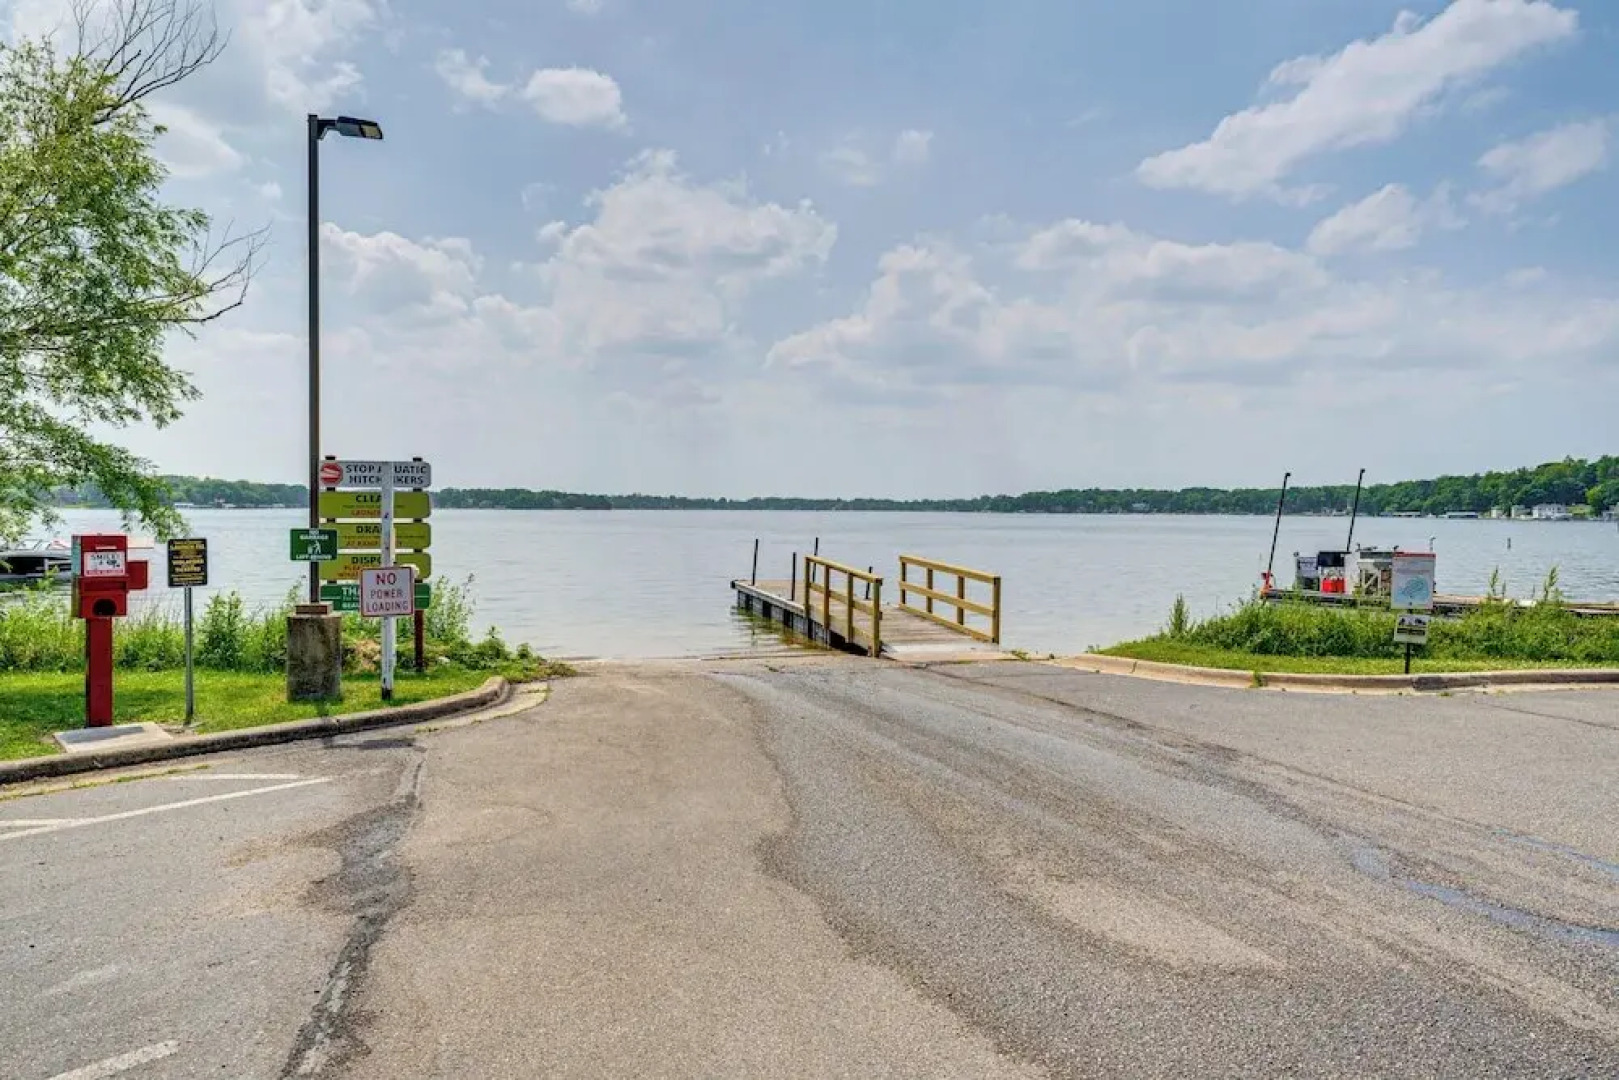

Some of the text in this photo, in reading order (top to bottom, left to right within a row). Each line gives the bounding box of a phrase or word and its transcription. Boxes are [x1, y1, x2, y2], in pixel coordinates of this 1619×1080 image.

[346, 464, 427, 474] STOP UATIC
[349, 475, 424, 484] HITCHIKERS
[356, 495, 382, 503] CLEA
[356, 525, 382, 534] DRA
[352, 556, 382, 564] DISP
[376, 573, 396, 585] NO
[370, 588, 404, 600] POWER
[366, 601, 409, 612] LOADING
